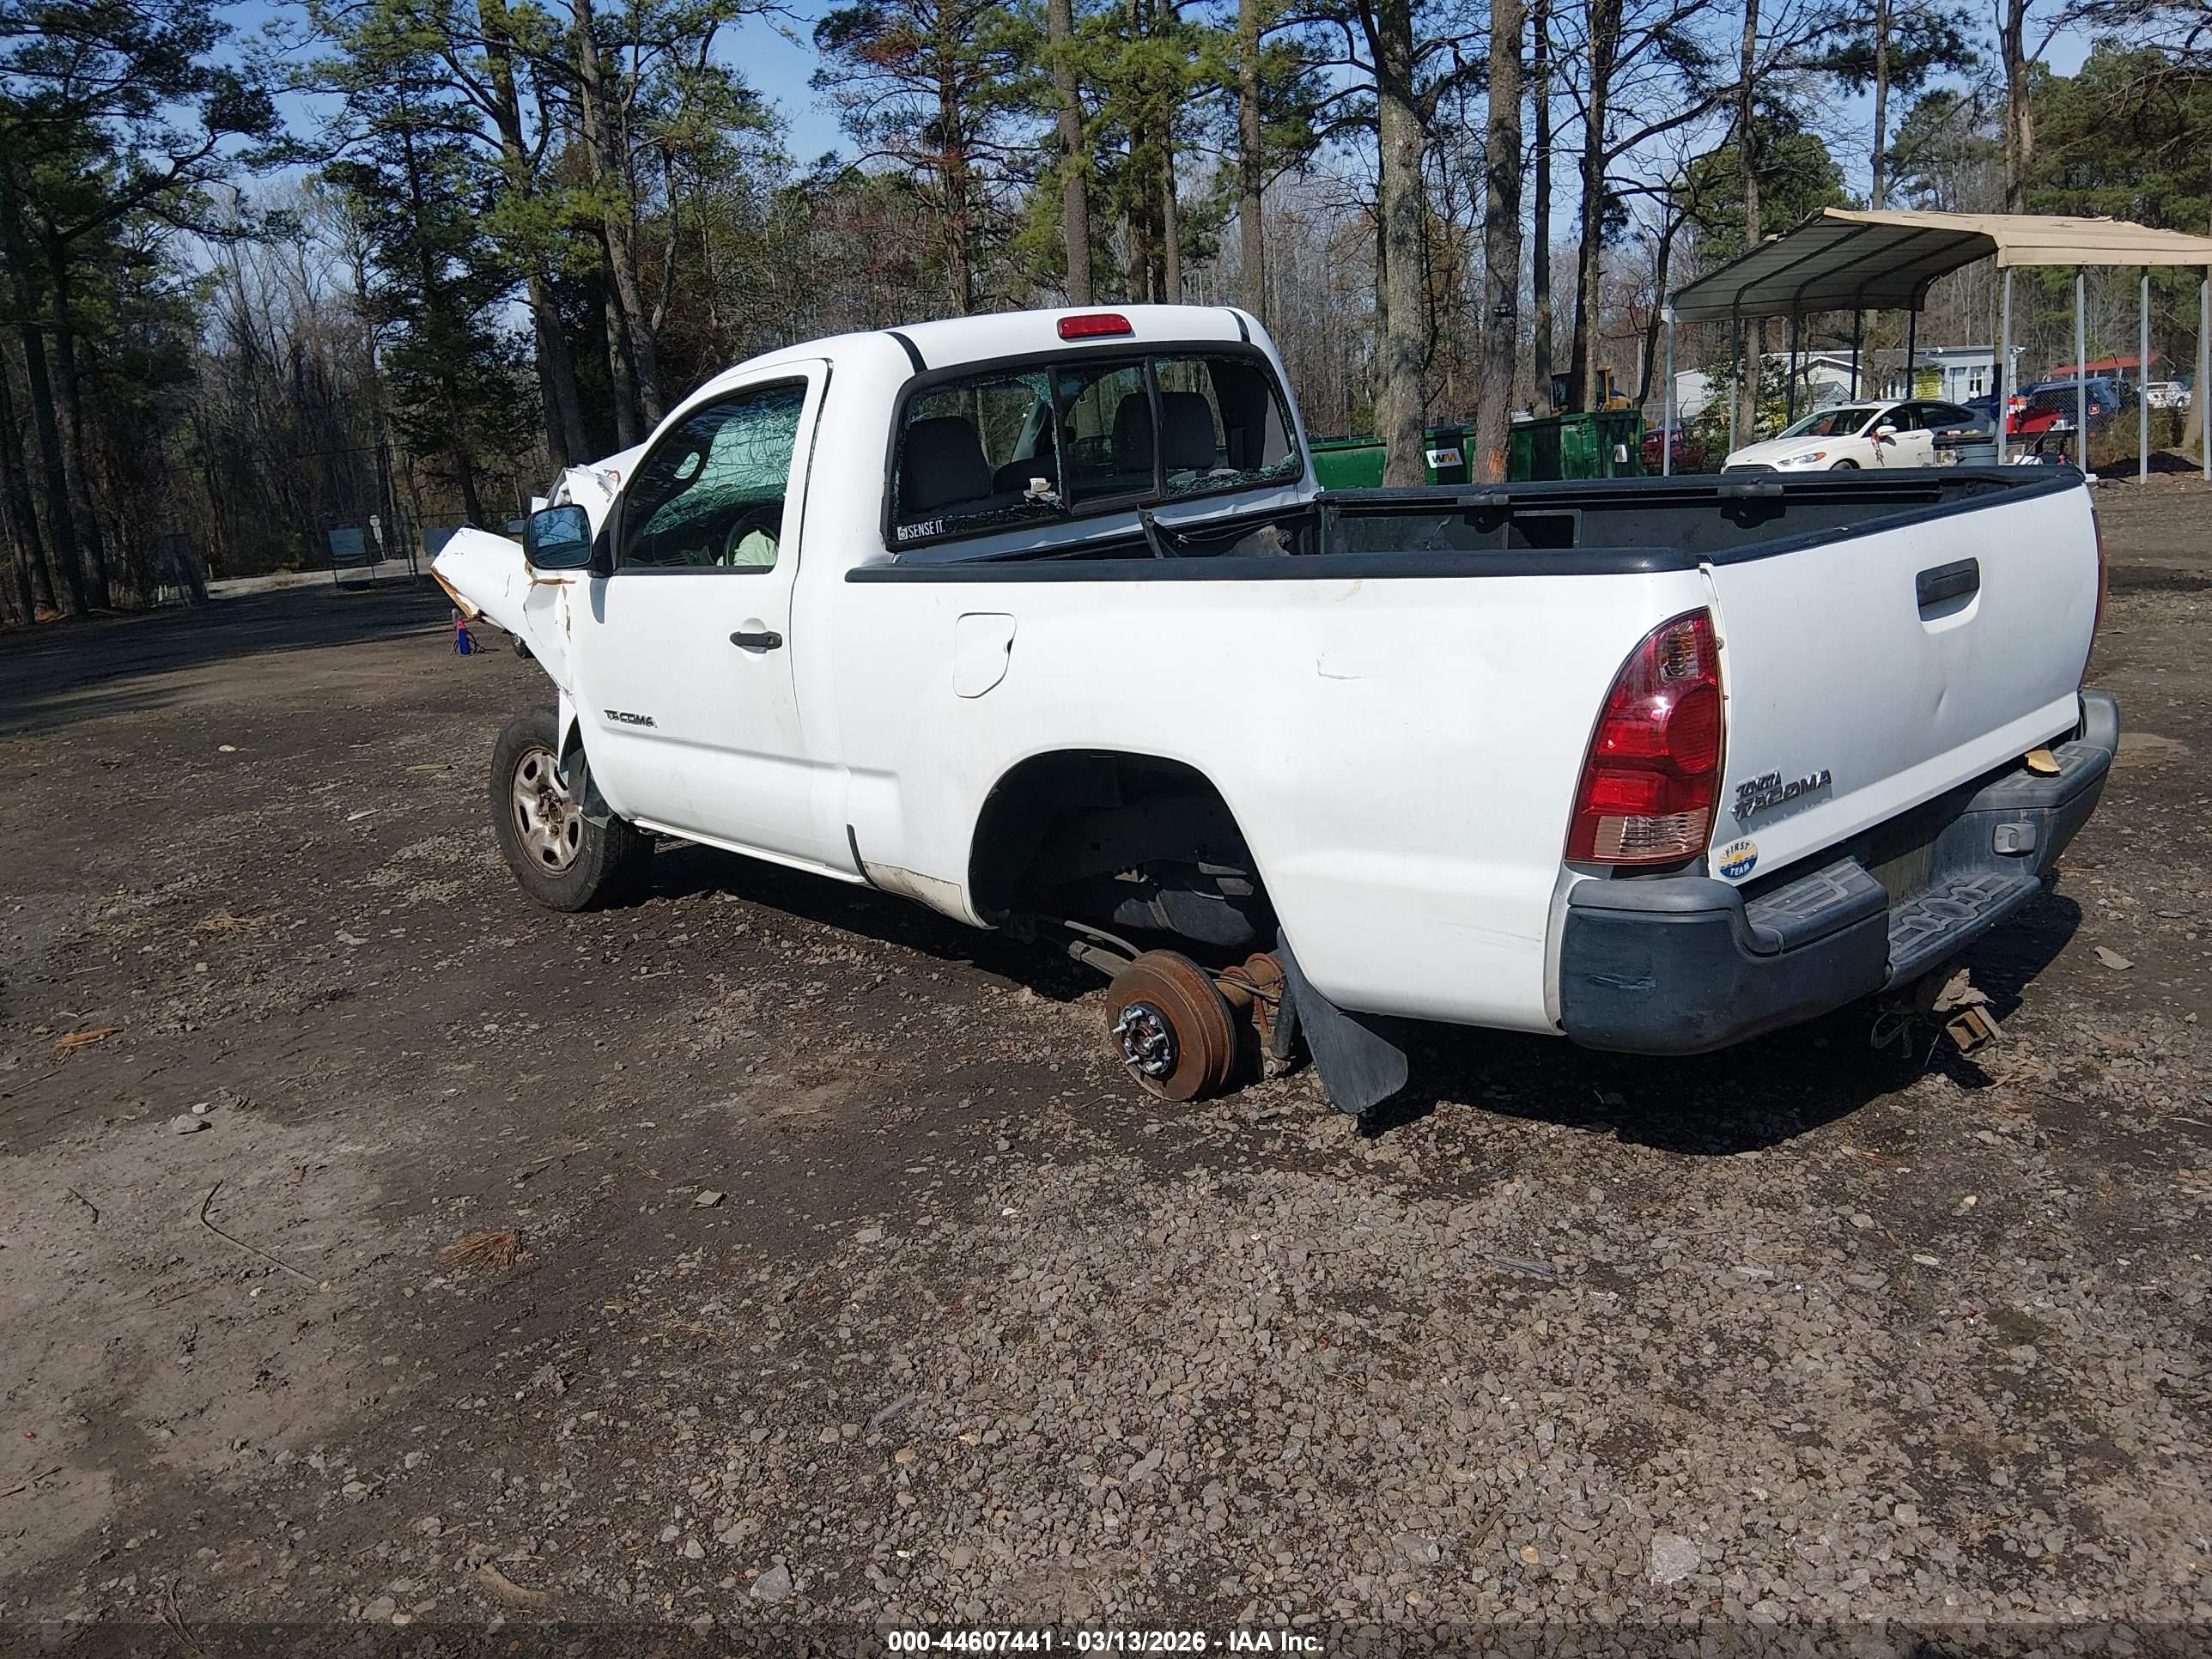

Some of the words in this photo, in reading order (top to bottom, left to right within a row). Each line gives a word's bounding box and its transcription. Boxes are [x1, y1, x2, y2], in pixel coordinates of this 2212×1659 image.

[1431, 453, 1457, 463] WM
[908, 520, 934, 538] SENSE
[604, 708, 658, 728] TACOMA
[1735, 771, 1782, 797] TOYOTA
[1730, 769, 1832, 822] TACOMA
[1725, 841, 1750, 858] FIRST
[1729, 863, 1751, 877] TEAM
